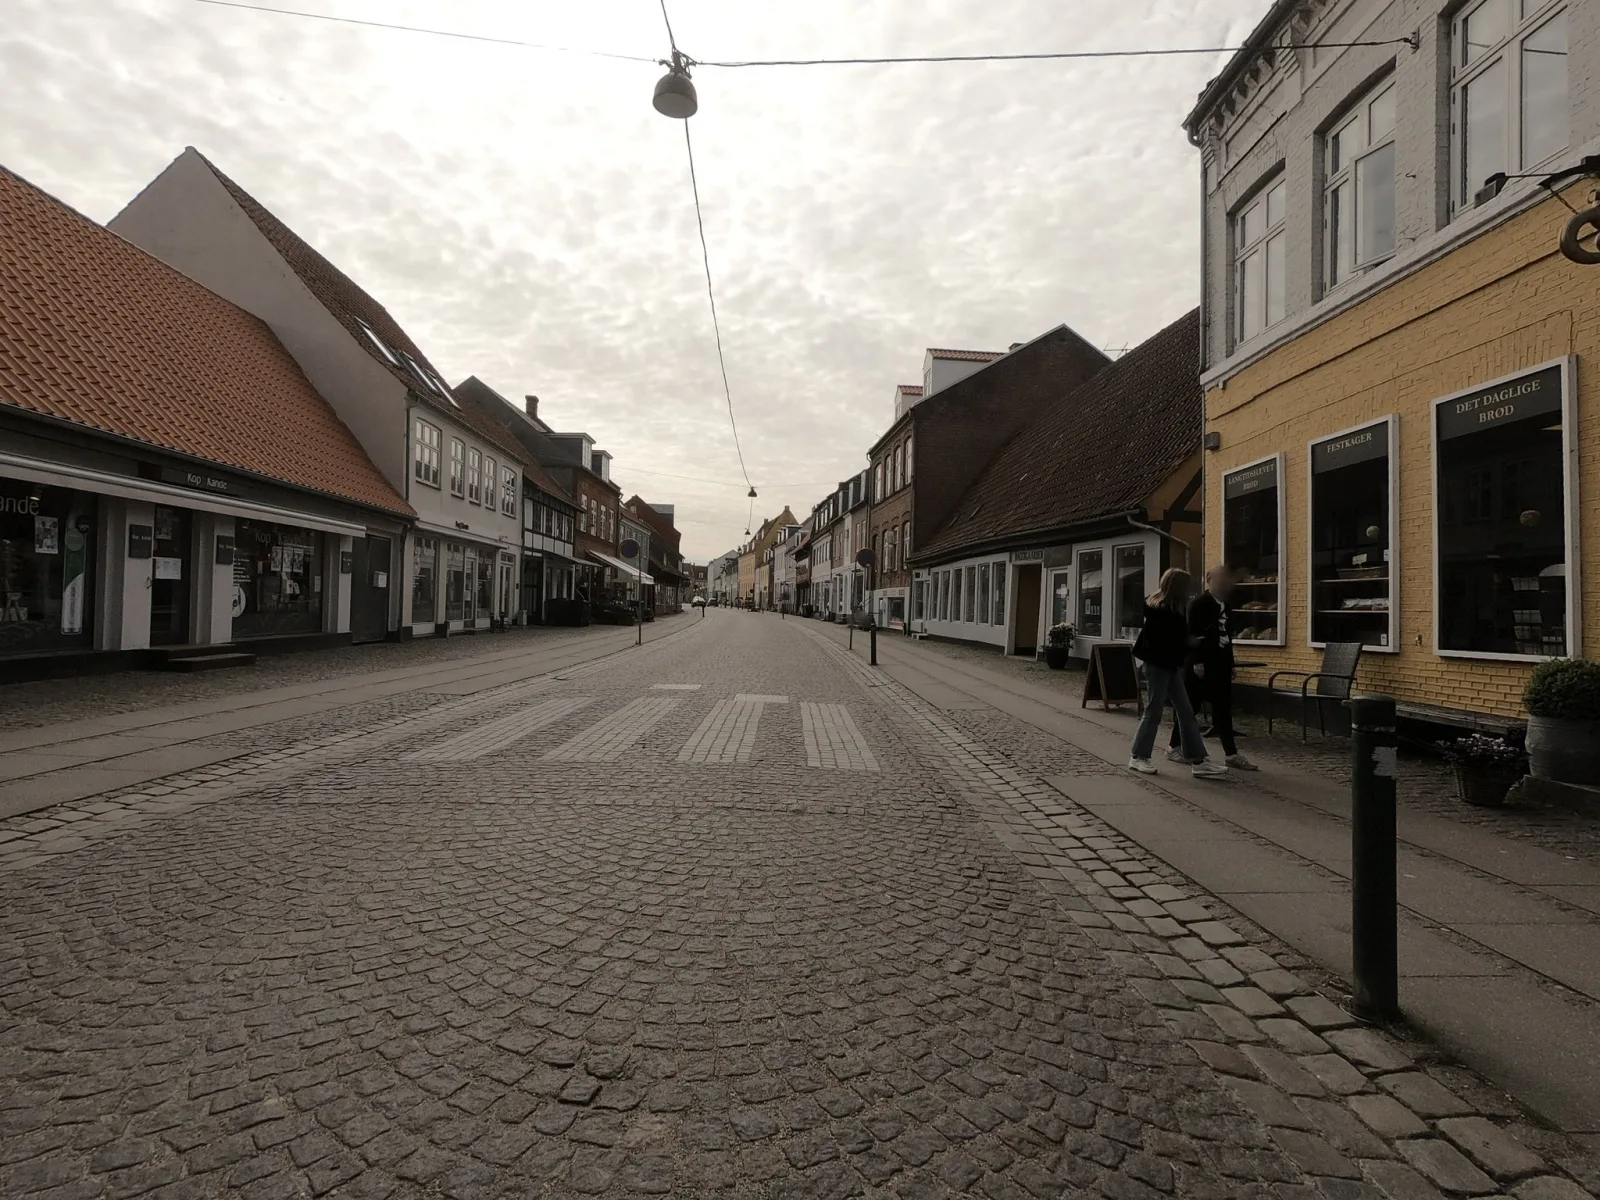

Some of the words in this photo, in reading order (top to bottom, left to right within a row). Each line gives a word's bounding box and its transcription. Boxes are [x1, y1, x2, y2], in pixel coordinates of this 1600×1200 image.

[1456, 398, 1480, 414] DET
[1483, 379, 1541, 406] DAGLIGE
[1479, 405, 1514, 423] BRØD
[1327, 432, 1372, 453] FESTKAGER
[187, 473, 202, 486] Kop
